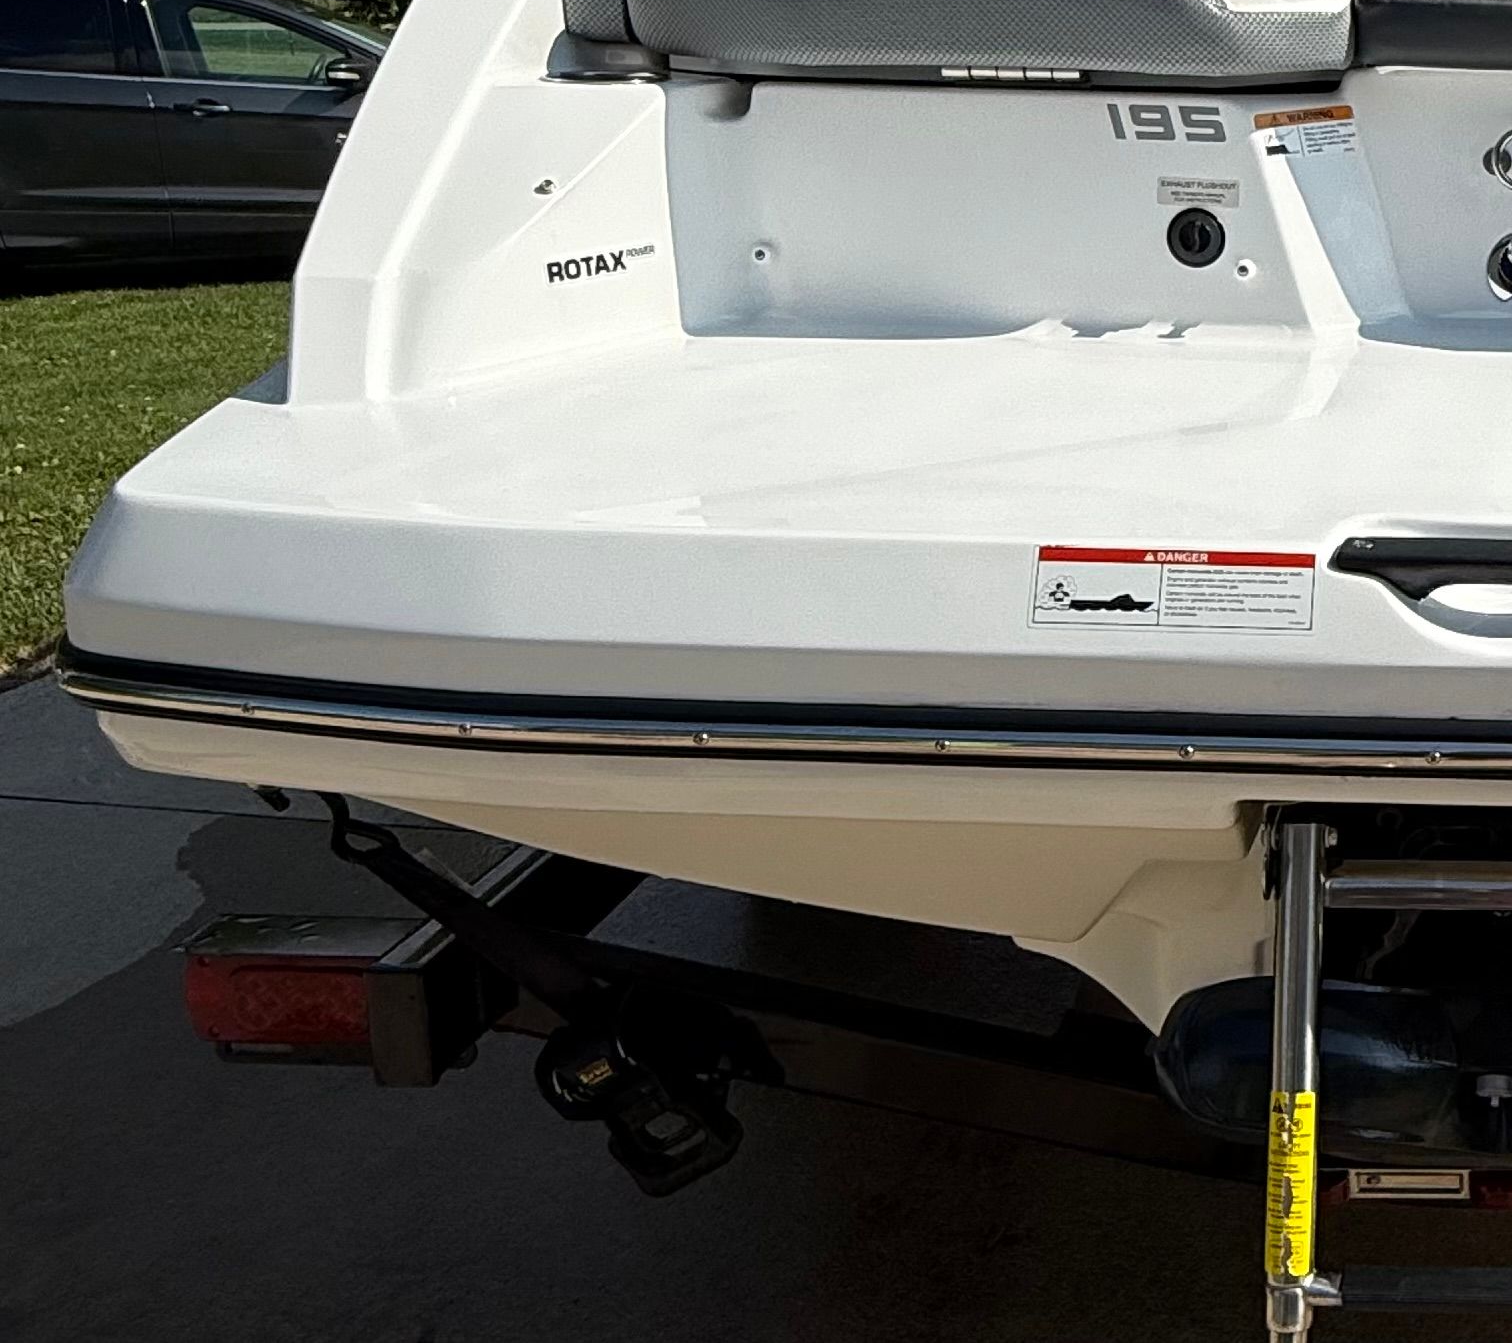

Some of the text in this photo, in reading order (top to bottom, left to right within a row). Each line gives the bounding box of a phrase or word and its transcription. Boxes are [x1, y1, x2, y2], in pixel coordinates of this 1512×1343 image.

[1106, 103, 1227, 142] 195
[546, 250, 627, 283] ROTAX
[1157, 552, 1209, 563] DANGER
